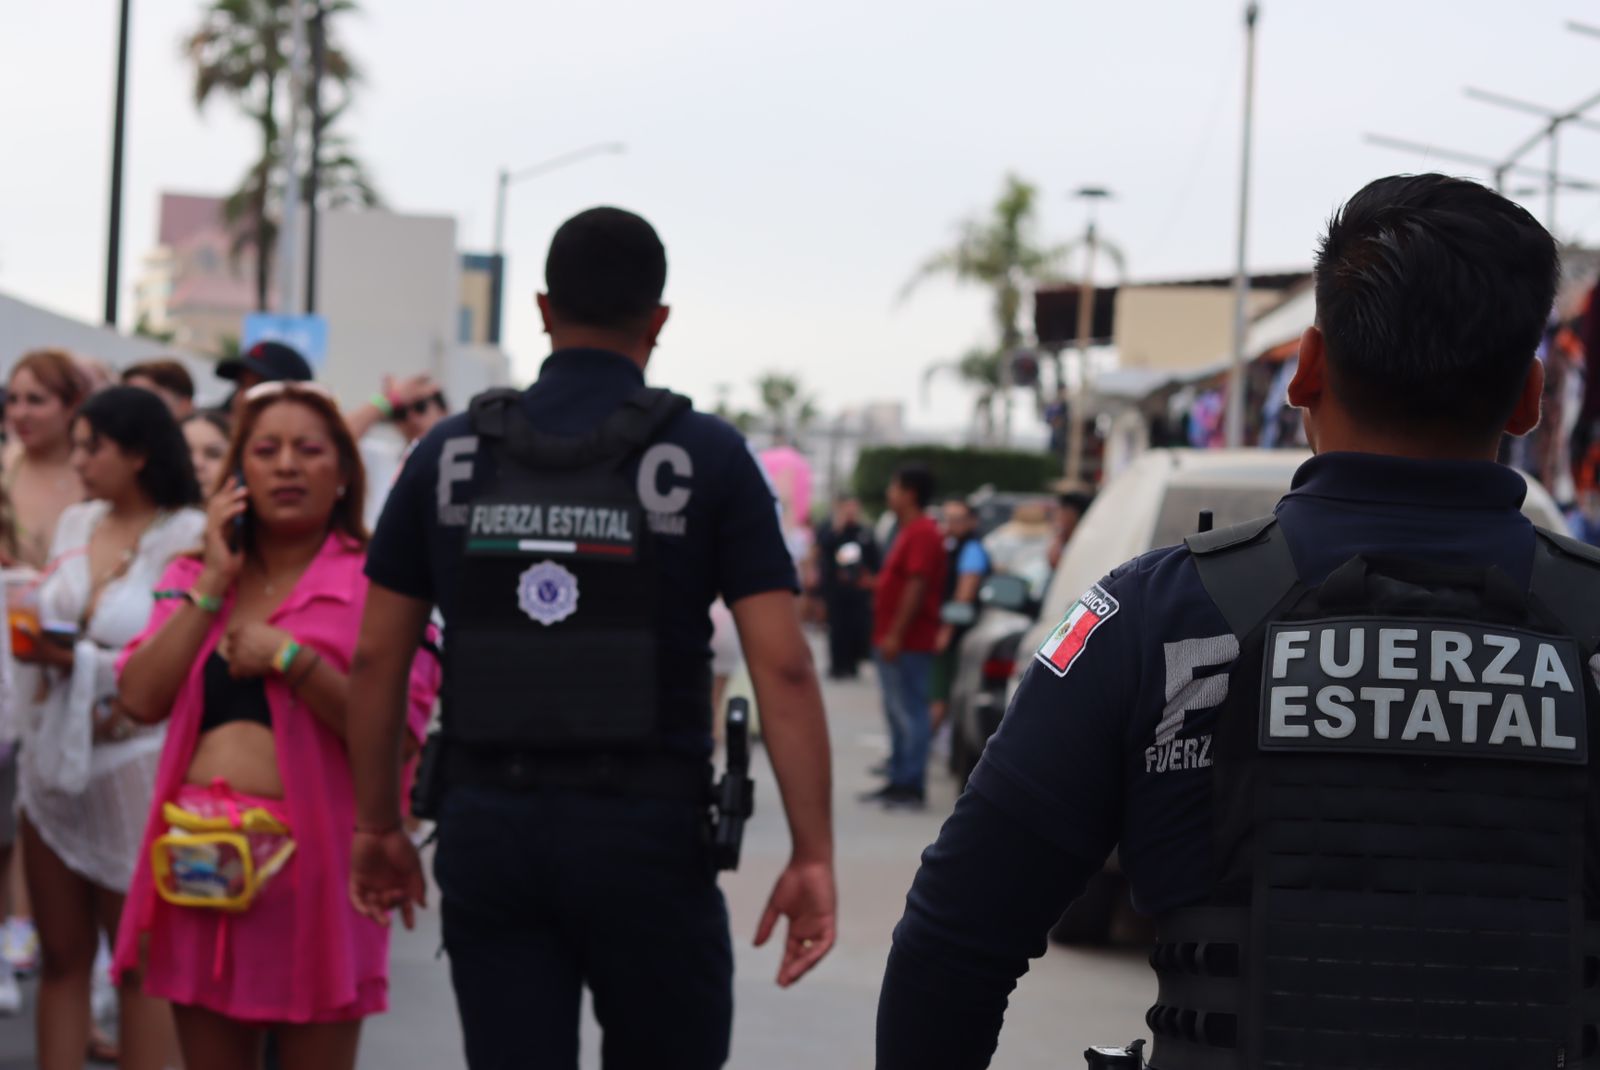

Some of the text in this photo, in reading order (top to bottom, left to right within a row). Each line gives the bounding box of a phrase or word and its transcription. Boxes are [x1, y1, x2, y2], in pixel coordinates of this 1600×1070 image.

[636, 443, 693, 513] C
[470, 503, 543, 535] FUERZA
[547, 505, 633, 541] ESTATAL
[1156, 633, 1240, 746] F
[1272, 627, 1575, 693] FUERZA
[1269, 684, 1577, 750] ESTATAL
[1145, 734, 1214, 773] FUERZ
